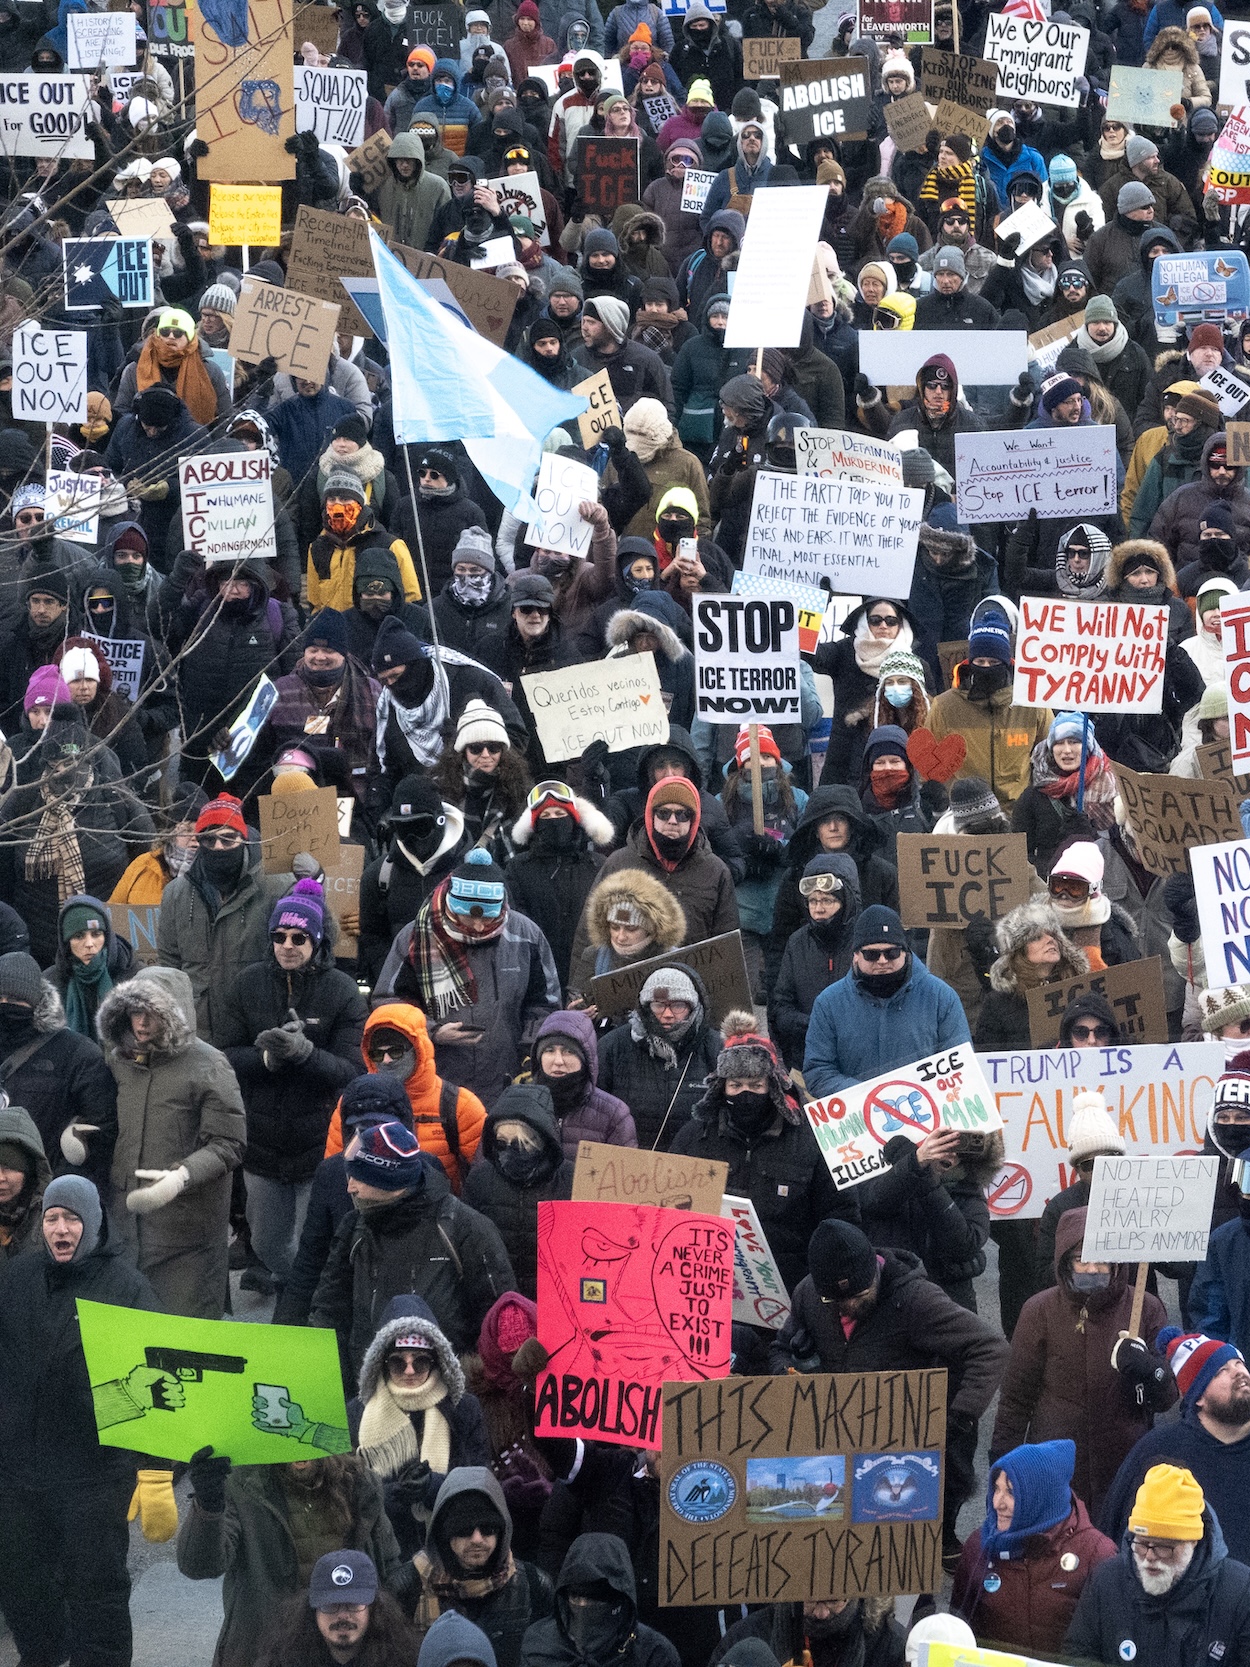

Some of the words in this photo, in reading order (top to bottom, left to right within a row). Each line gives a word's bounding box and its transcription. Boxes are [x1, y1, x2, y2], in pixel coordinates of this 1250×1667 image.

[77, 17, 112, 27] HISTORY
[115, 17, 123, 26] IS
[414, 11, 446, 26] FUCK
[861, 14, 874, 23] for
[861, 22, 930, 33] LEAVENWORTH
[991, 14, 1017, 41] We
[1045, 24, 1081, 50] Our
[986, 41, 1074, 73] Immigrant
[782, 73, 866, 112] ABOLISH
[996, 64, 1077, 102] Neighbors!
[4, 118, 23, 132] For
[812, 109, 847, 137] ICE
[304, 230, 356, 251] Timeline!
[116, 241, 148, 272] ICE
[1159, 260, 1175, 273] NO
[1176, 259, 1208, 272] HUMAN
[117, 271, 149, 301] OUT
[1159, 272, 1171, 284] IS
[1171, 270, 1208, 283] ILLEGAL
[253, 288, 316, 320] ARREST
[20, 332, 73, 357] ICE
[236, 310, 319, 370] ICE
[16, 361, 78, 384] OUT
[1208, 370, 1228, 388] ICE
[1224, 383, 1250, 403] OUT
[20, 387, 83, 413] NOW
[798, 430, 836, 452] STOP
[841, 434, 902, 466] DETAINING
[183, 457, 270, 485] ABOLISH
[806, 450, 818, 468] &
[832, 451, 901, 480] MURDERING
[49, 474, 99, 495] JUSTICE
[964, 485, 1004, 512] Stop
[1015, 481, 1043, 504] ICE
[756, 503, 797, 524] REJECT
[800, 507, 820, 524] THE
[826, 509, 877, 528] EVIDENCE
[881, 515, 896, 529] OF
[752, 526, 777, 543] EYES
[783, 530, 805, 544] AND
[807, 530, 836, 545] EARS.
[839, 531, 851, 546] IT
[852, 531, 875, 549] WAS
[877, 534, 905, 550] THEIR
[751, 545, 792, 567] FINAL,
[793, 550, 822, 566] MOST
[823, 553, 881, 569] ESSENTIAL
[697, 600, 795, 653] STOP
[1022, 601, 1067, 633] WE
[1075, 605, 1119, 639] Will
[1122, 606, 1168, 642] Not
[699, 665, 726, 690] ICE
[728, 666, 797, 691] TERROR
[532, 682, 600, 709] Queridos
[698, 696, 800, 714] NOW!
[567, 701, 606, 722] Estoy
[271, 800, 320, 822] Down
[920, 846, 1007, 877] FUCK
[925, 877, 1013, 923] ICE
[916, 1050, 965, 1082] ICE
[986, 1050, 1082, 1085] TRUMP
[1099, 1047, 1134, 1078] IS
[1162, 1047, 1185, 1071] A
[936, 1071, 964, 1092] OUT
[807, 1097, 847, 1127] NO
[836, 1140, 864, 1164] IS
[1101, 1159, 1145, 1182] NOT
[1155, 1158, 1214, 1181] EVEN
[1102, 1185, 1185, 1209] HEATED
[1100, 1208, 1174, 1229] RIVALRY
[687, 1227, 729, 1251] IT'S
[1094, 1231, 1147, 1252] HELPS
[1150, 1230, 1210, 1251] ANYMORE
[672, 1245, 723, 1266] NEVER
[658, 1261, 675, 1277] A
[679, 1262, 731, 1285] CRIME
[679, 1279, 728, 1300] JUST
[687, 1297, 709, 1317] TO
[669, 1312, 725, 1338] EXIST
[534, 1372, 663, 1443] ABOLISH
[664, 1379, 774, 1457] THIS
[785, 1369, 948, 1452] MACHINE
[666, 1530, 793, 1604] DEFEATS
[803, 1521, 944, 1598] TYRANNY
